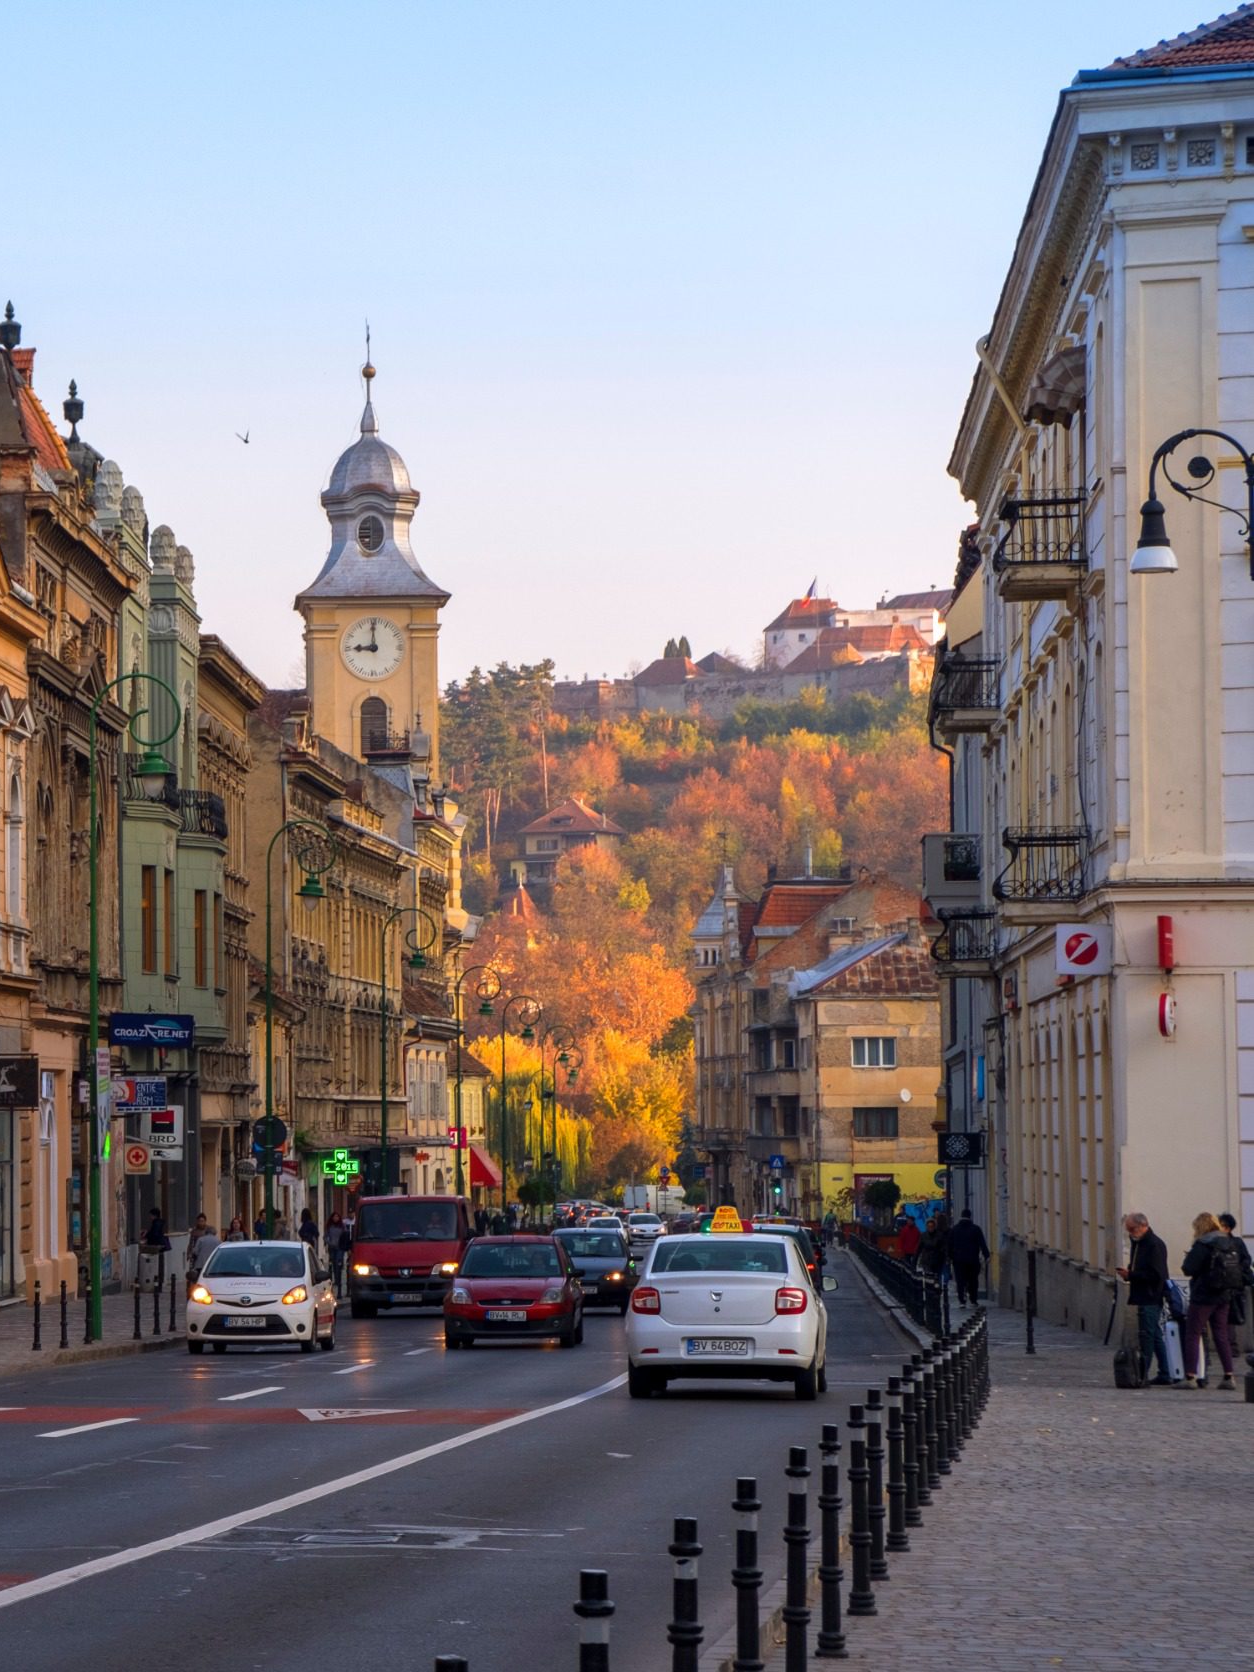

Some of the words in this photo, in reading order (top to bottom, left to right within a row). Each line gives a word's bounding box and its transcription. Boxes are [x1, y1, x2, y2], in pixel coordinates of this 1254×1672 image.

[149, 1135, 176, 1144] BRD
[725, 1222, 741, 1230] TAXI
[694, 1341, 708, 1351] BV
